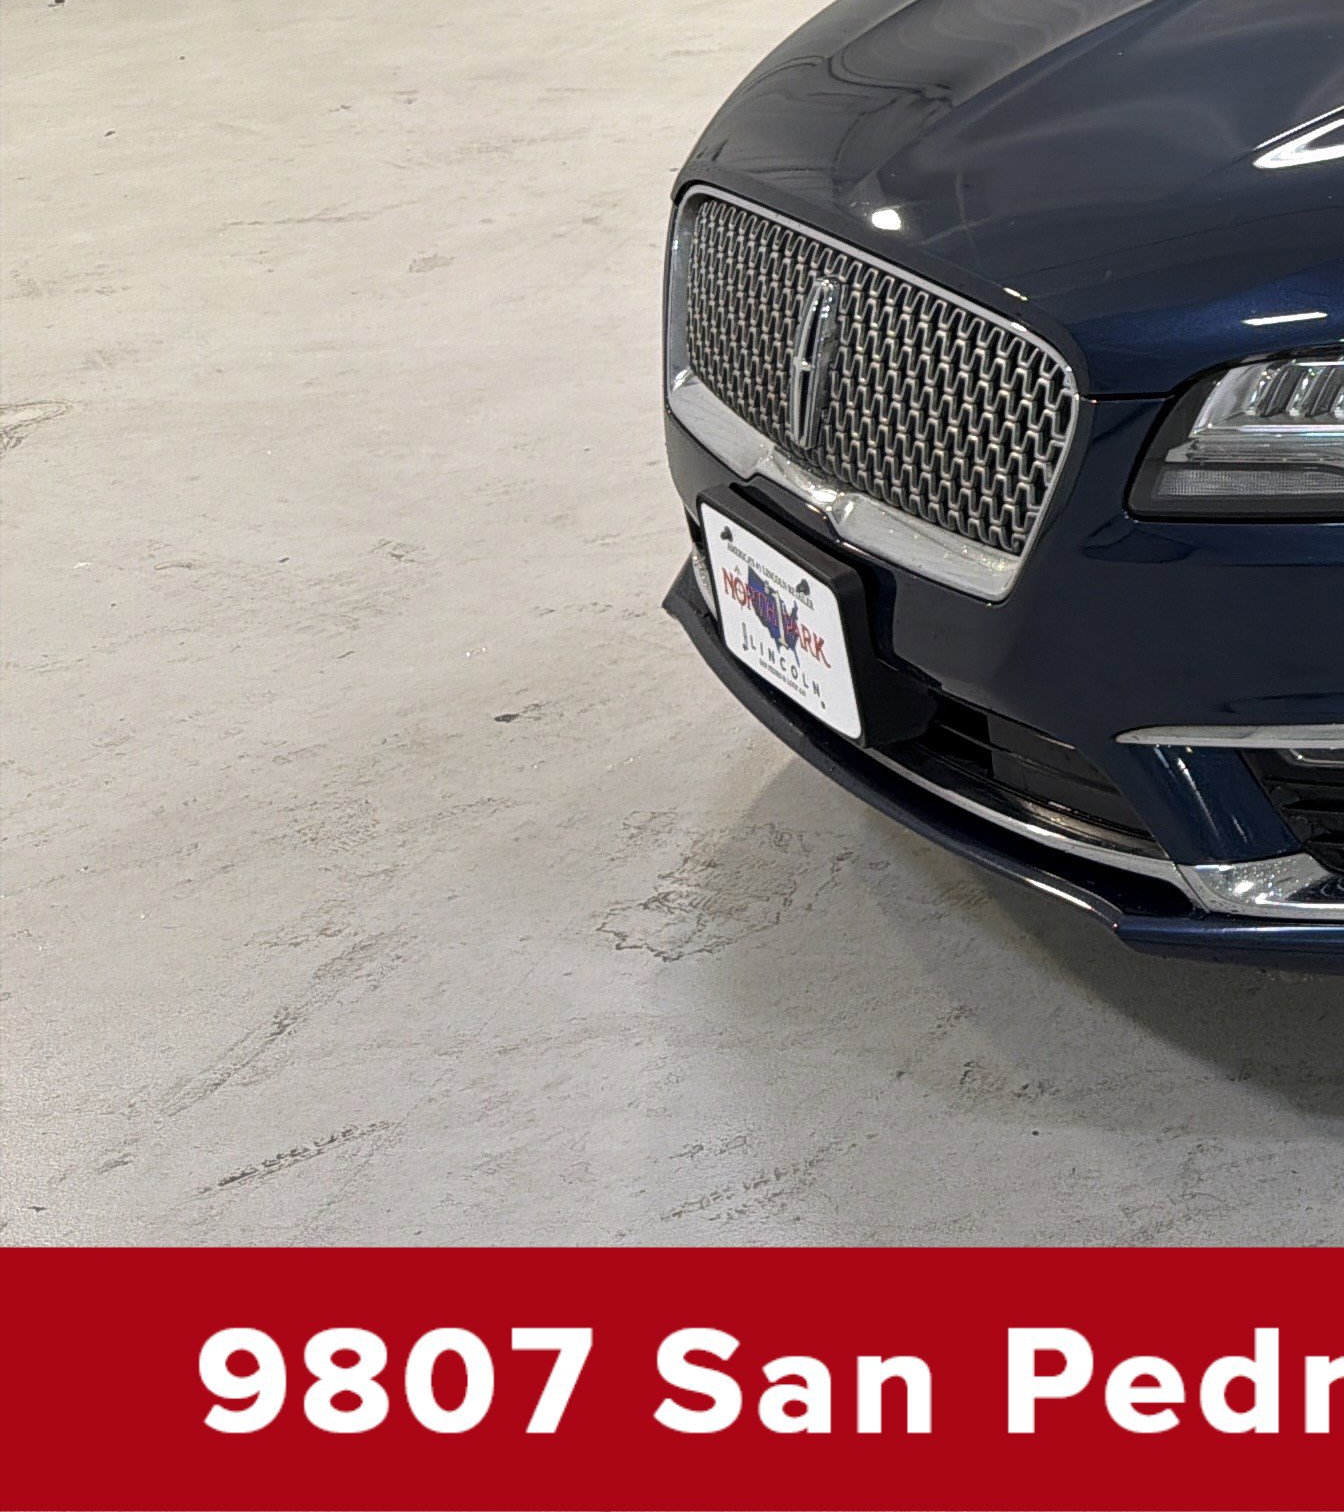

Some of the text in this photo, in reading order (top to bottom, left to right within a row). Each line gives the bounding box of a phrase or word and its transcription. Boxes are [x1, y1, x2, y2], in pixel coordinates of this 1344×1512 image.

[721, 566, 832, 669] NORTH PARK
[749, 634, 821, 698] LINCOLN
